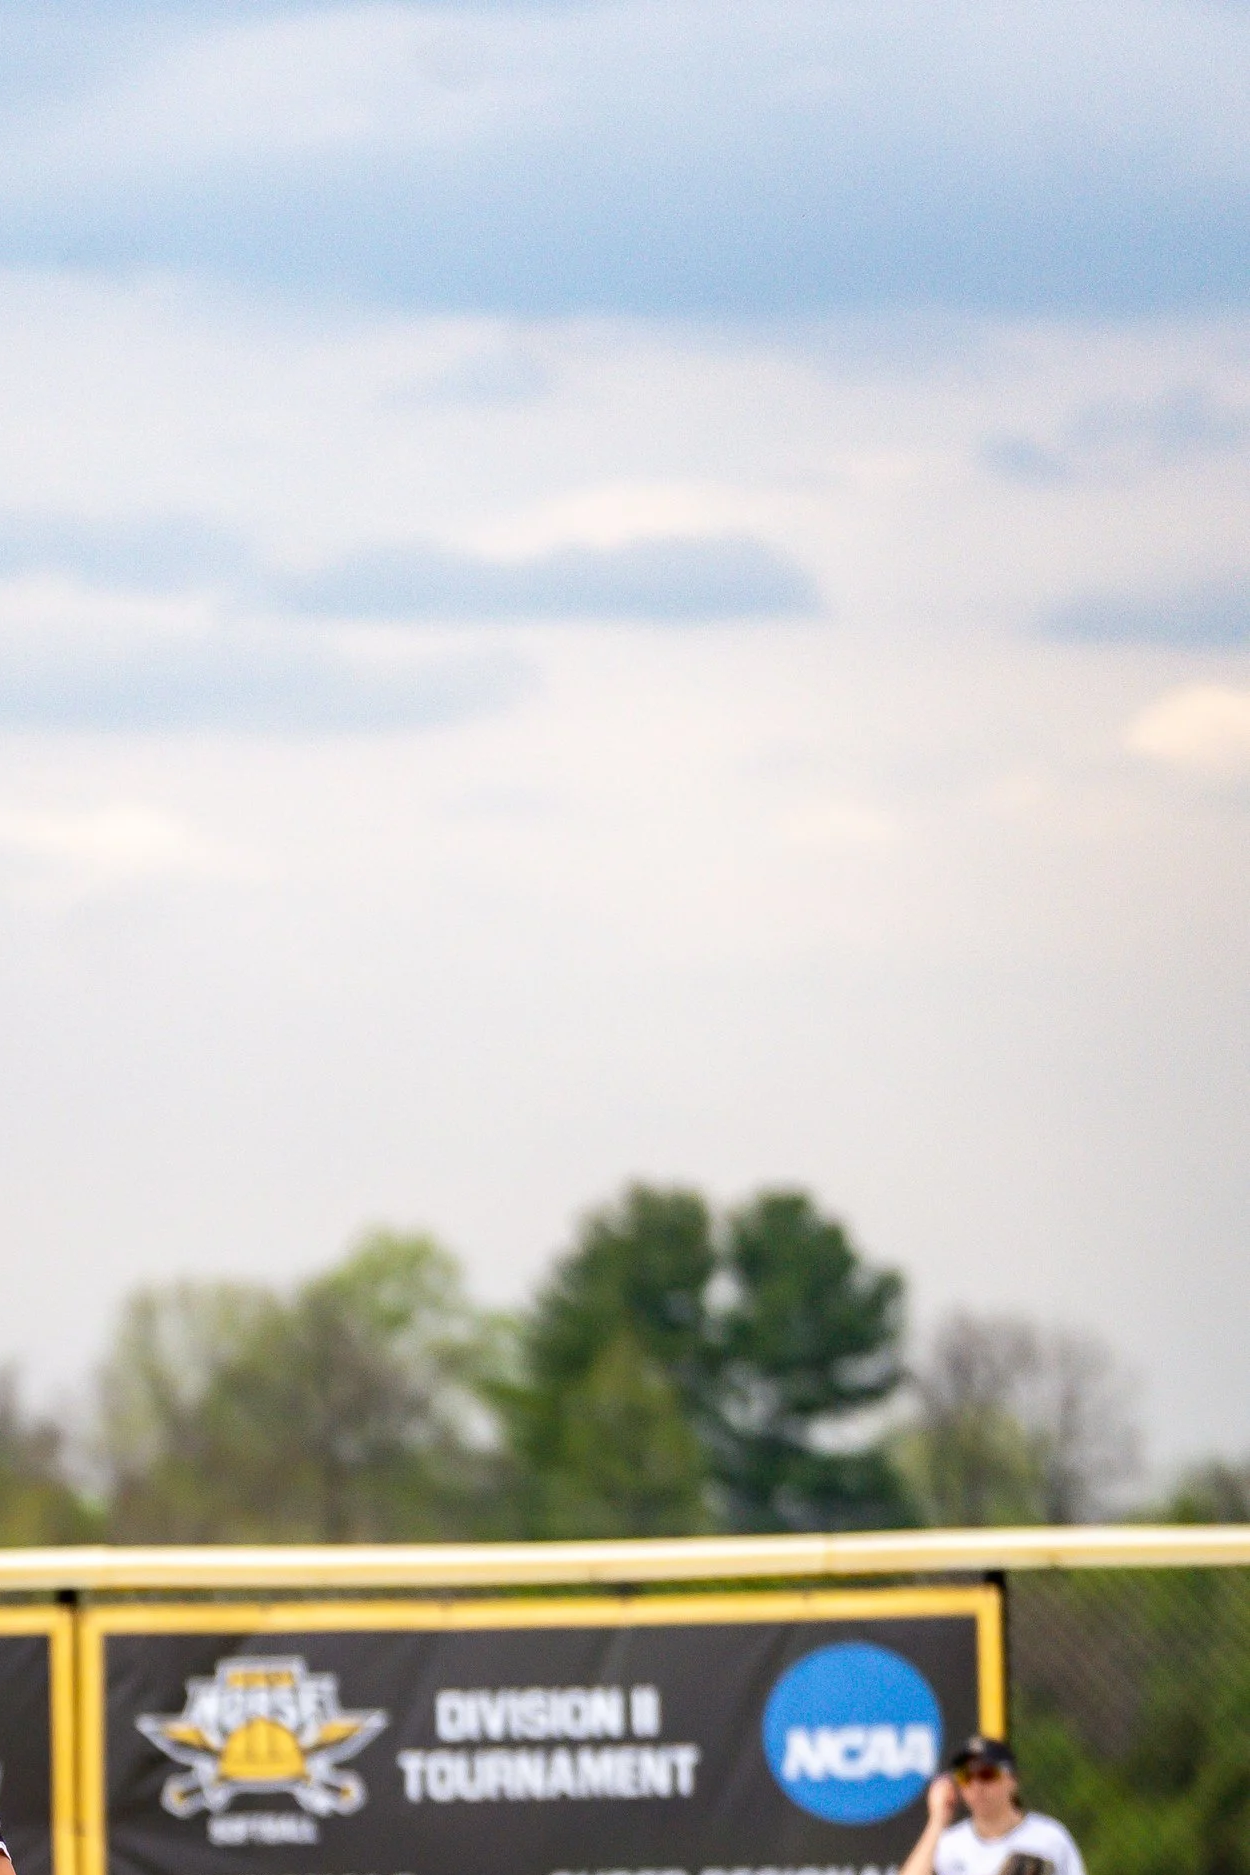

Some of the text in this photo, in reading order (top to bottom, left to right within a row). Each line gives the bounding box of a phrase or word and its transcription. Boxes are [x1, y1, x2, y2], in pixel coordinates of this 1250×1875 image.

[436, 1688, 659, 1740] DIVISION II
[399, 1747, 697, 1800] TOURNAMENT
[783, 1724, 937, 1783] NCAA
